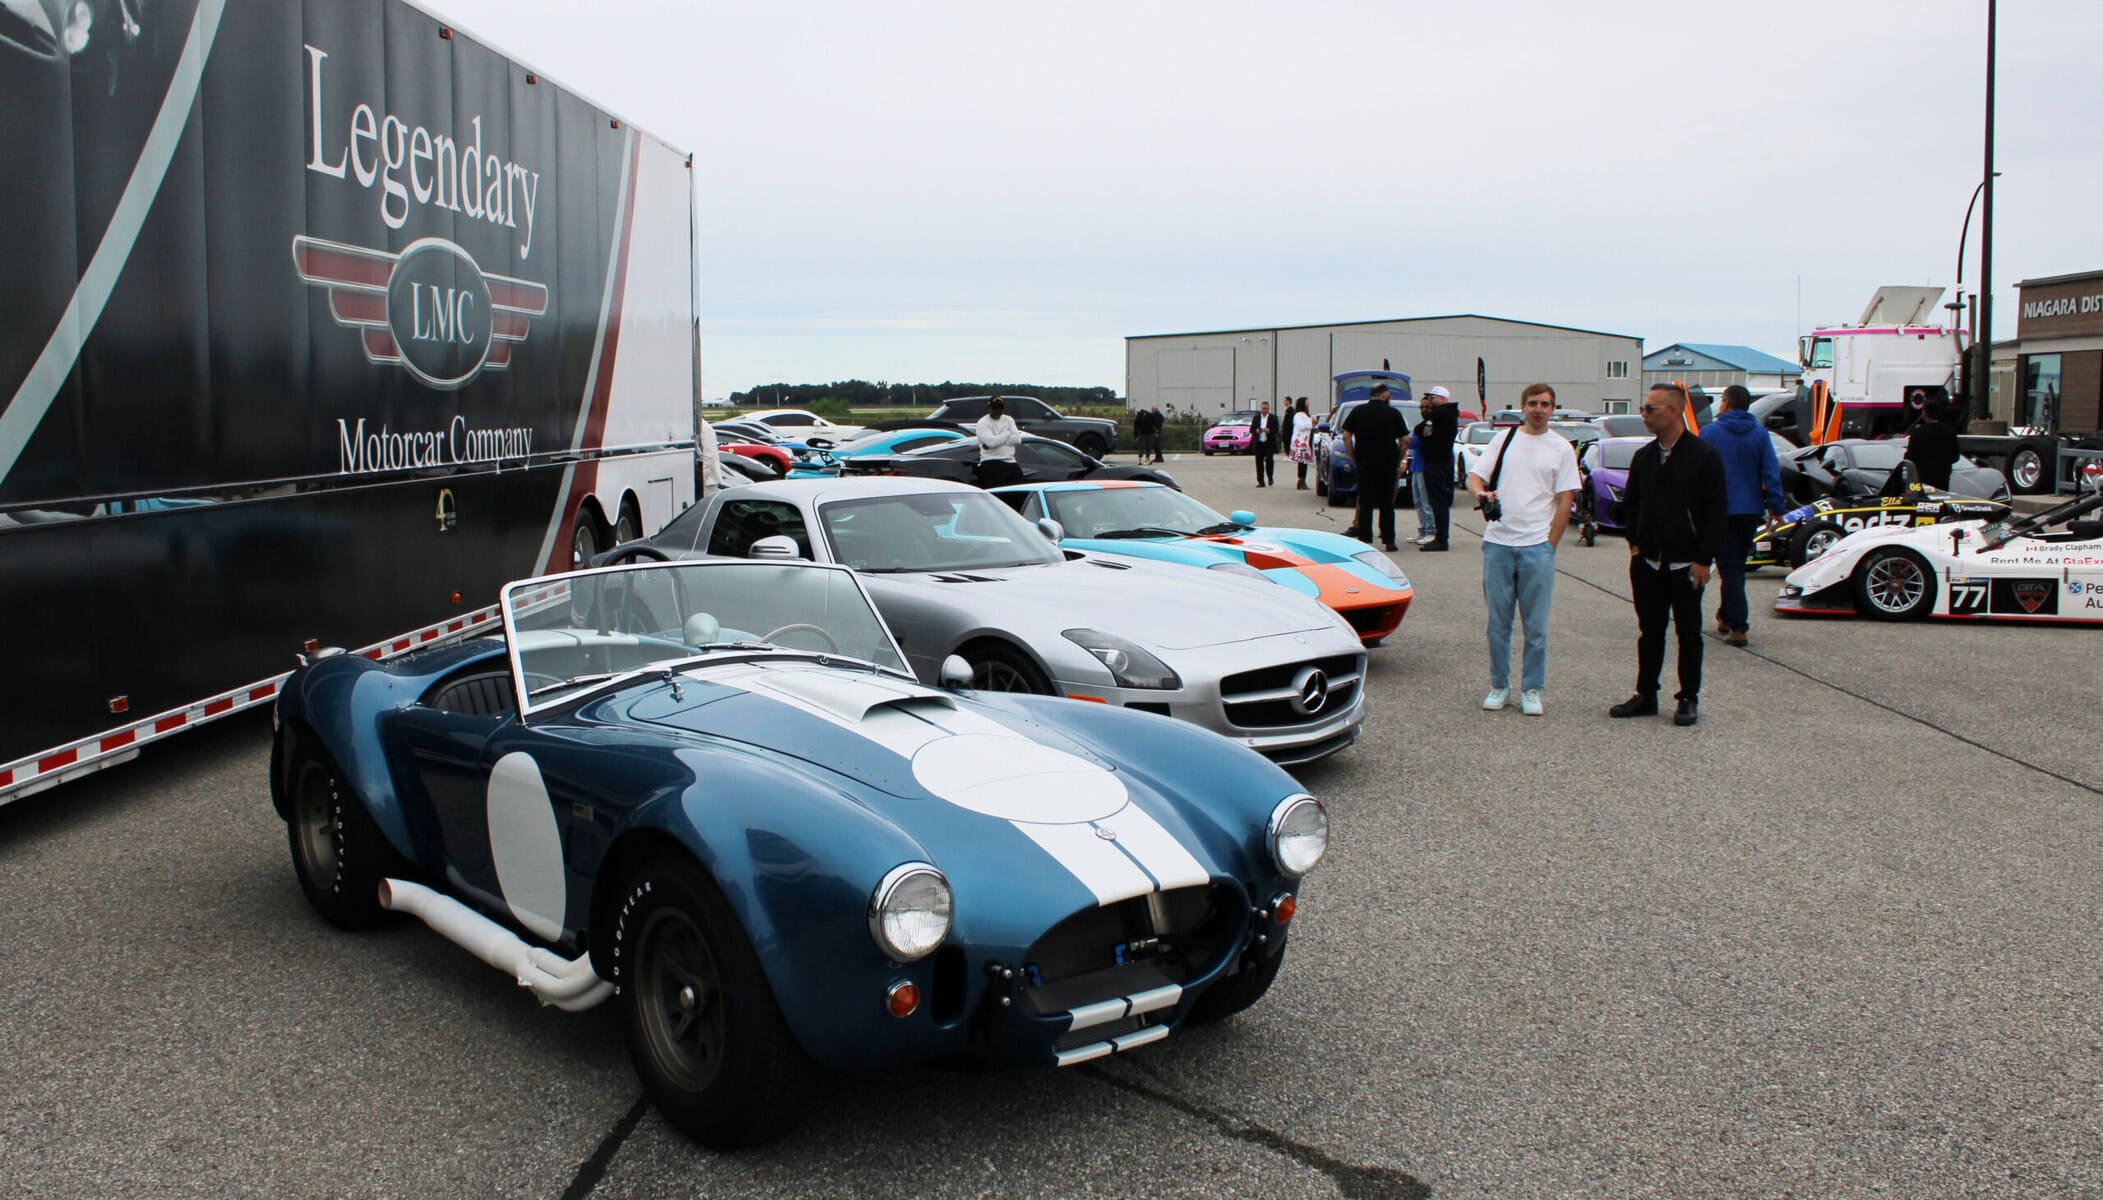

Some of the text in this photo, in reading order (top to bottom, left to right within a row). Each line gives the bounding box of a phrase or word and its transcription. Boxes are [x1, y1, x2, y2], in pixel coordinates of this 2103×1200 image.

[304, 44, 539, 259] Legendary
[410, 282, 475, 344] LMC
[2024, 298, 2077, 318] NIAGARA
[336, 414, 533, 475] Motorcar Company
[1909, 482, 1922, 492] 06
[1820, 510, 1911, 533] ertz
[1951, 585, 1987, 608] 77
[2086, 583, 2103, 594] Pe
